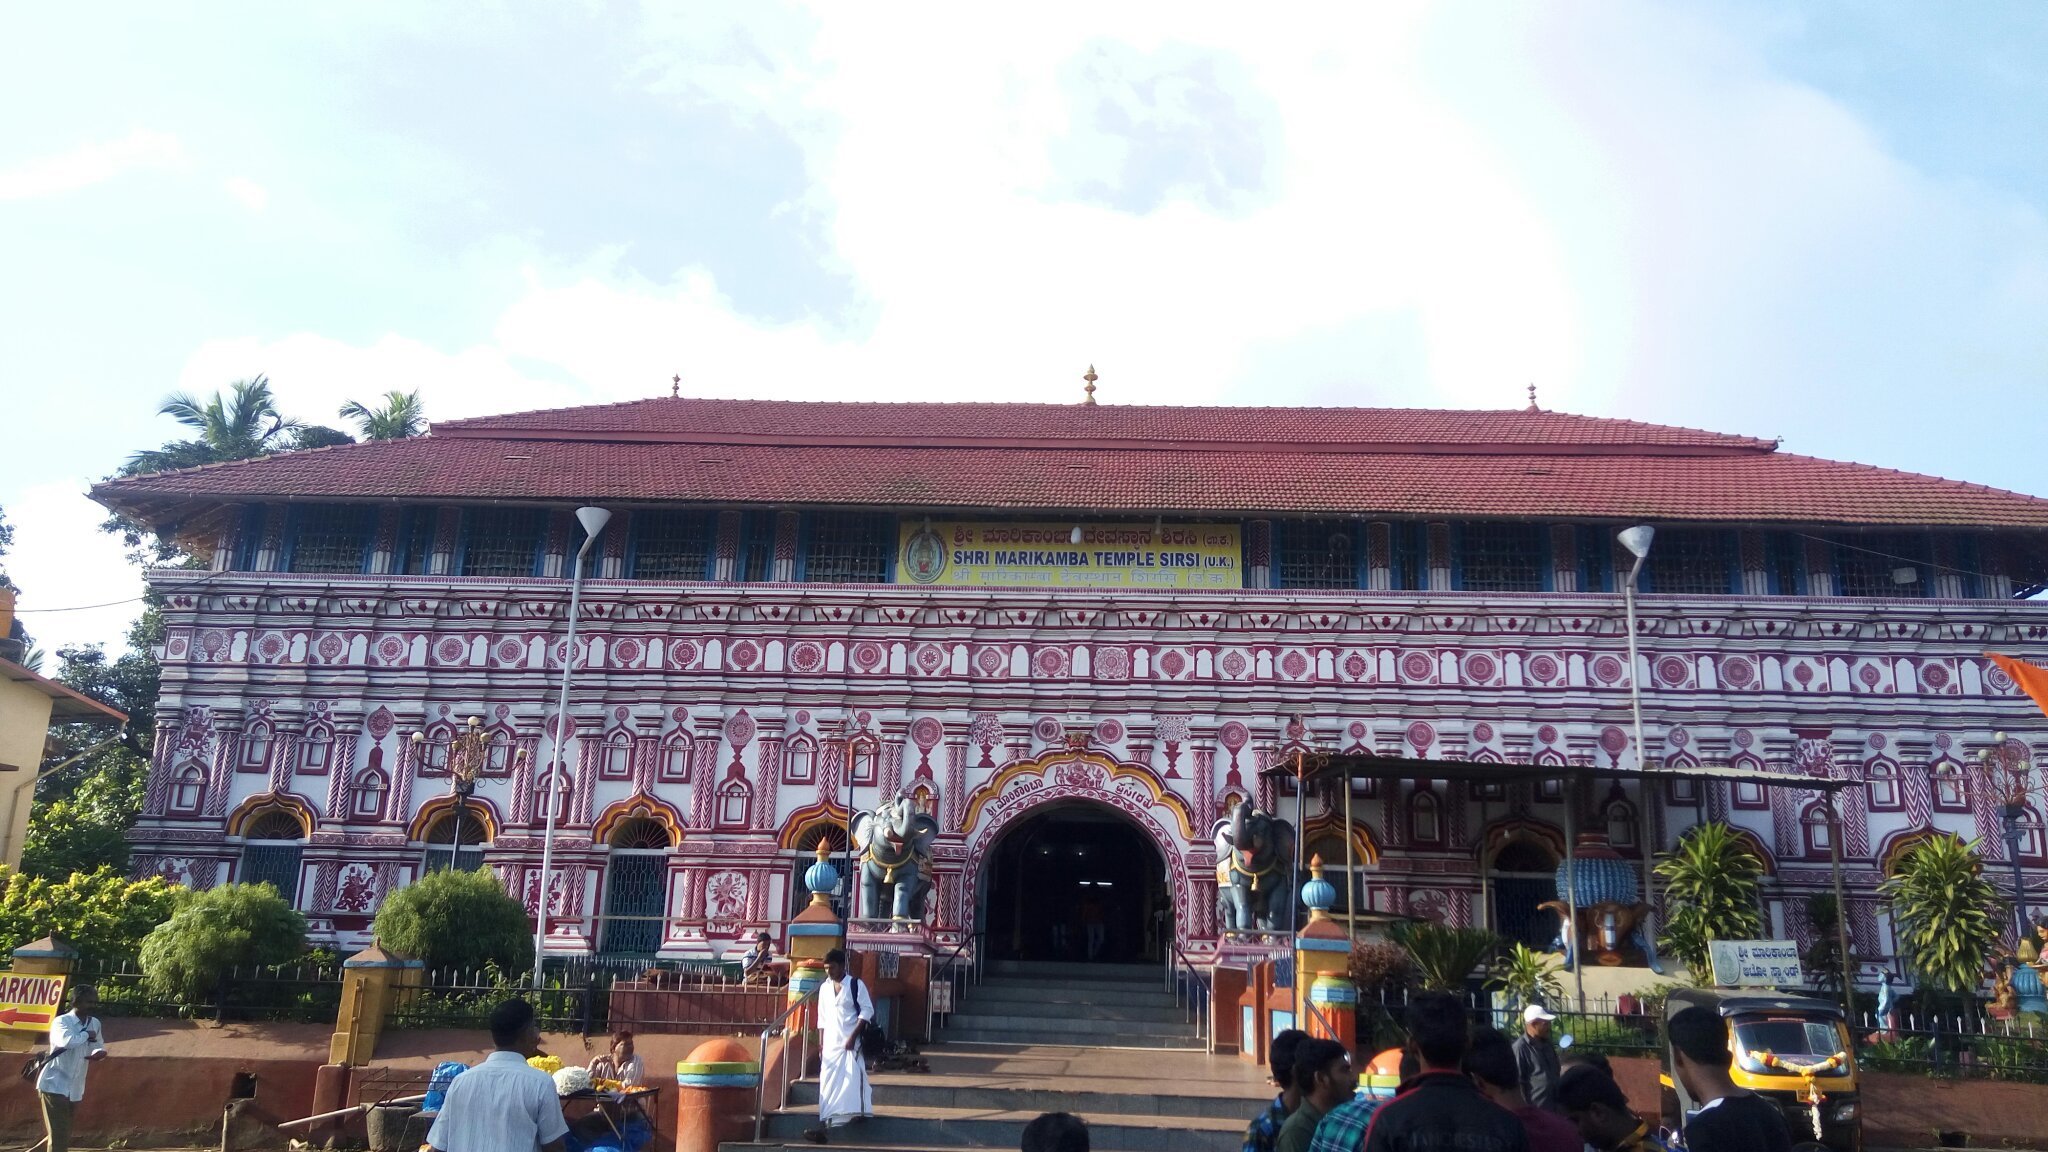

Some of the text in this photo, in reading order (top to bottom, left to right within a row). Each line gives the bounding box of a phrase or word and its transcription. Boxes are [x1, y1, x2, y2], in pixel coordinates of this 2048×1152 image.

[953, 525, 973, 547] ಶ್ರೀ
[1161, 528, 1197, 545] ಶಿರಸಿ
[954, 550, 1234, 569] SHRI MARIKAMBA TEMPLE SIRSI (U.K.)
